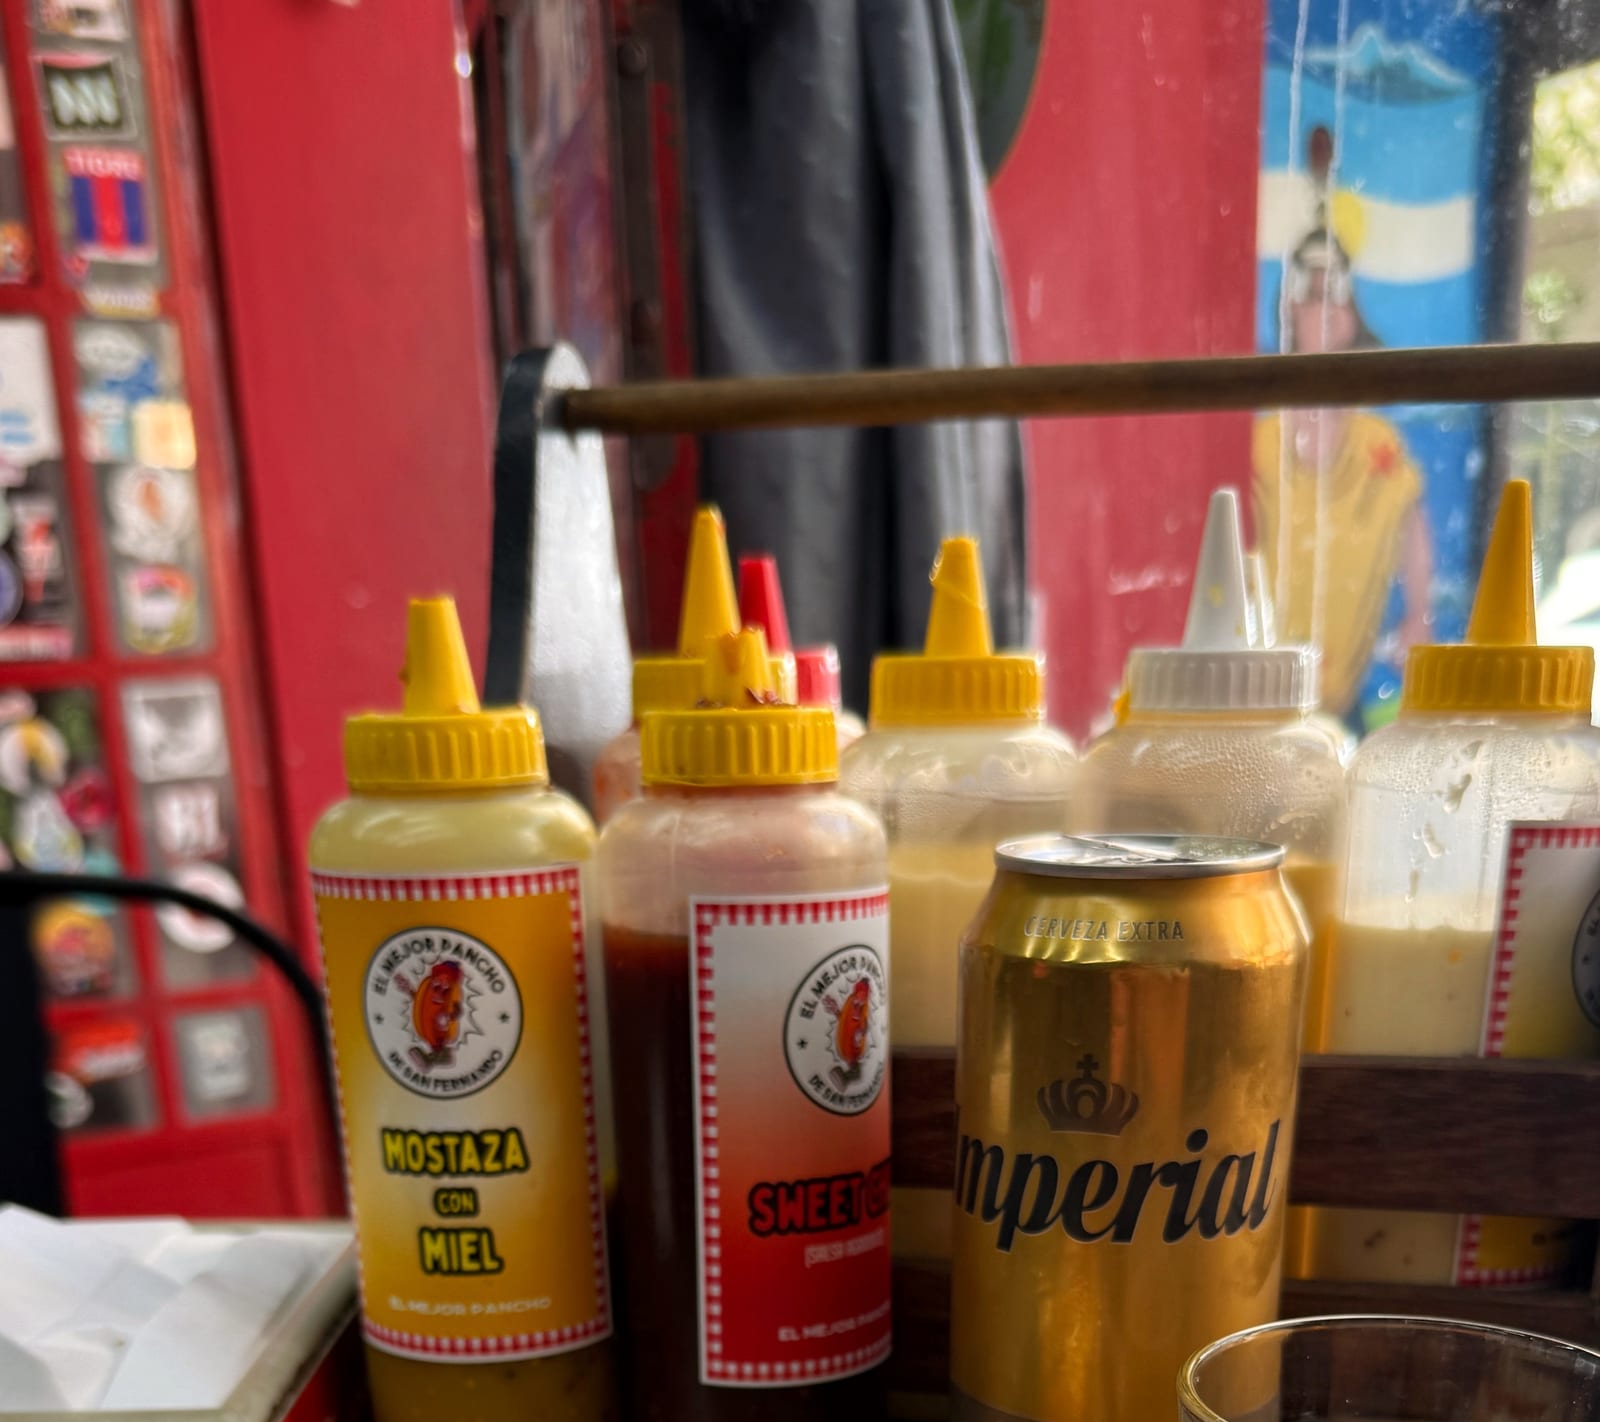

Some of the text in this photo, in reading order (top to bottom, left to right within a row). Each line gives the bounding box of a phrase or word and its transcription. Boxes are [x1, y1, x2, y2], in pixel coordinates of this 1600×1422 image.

[1023, 914, 1185, 942] CERVEZA EXTRA
[382, 937, 435, 975] MEJOR
[440, 938, 506, 995] PANCHO
[810, 956, 857, 999] MEJOR
[382, 1127, 530, 1177] MOSTAZA
[433, 1187, 479, 1218] CON
[749, 1172, 863, 1237] SWEET
[956, 1118, 1280, 1254] mperial
[419, 1226, 505, 1276] MIEL
